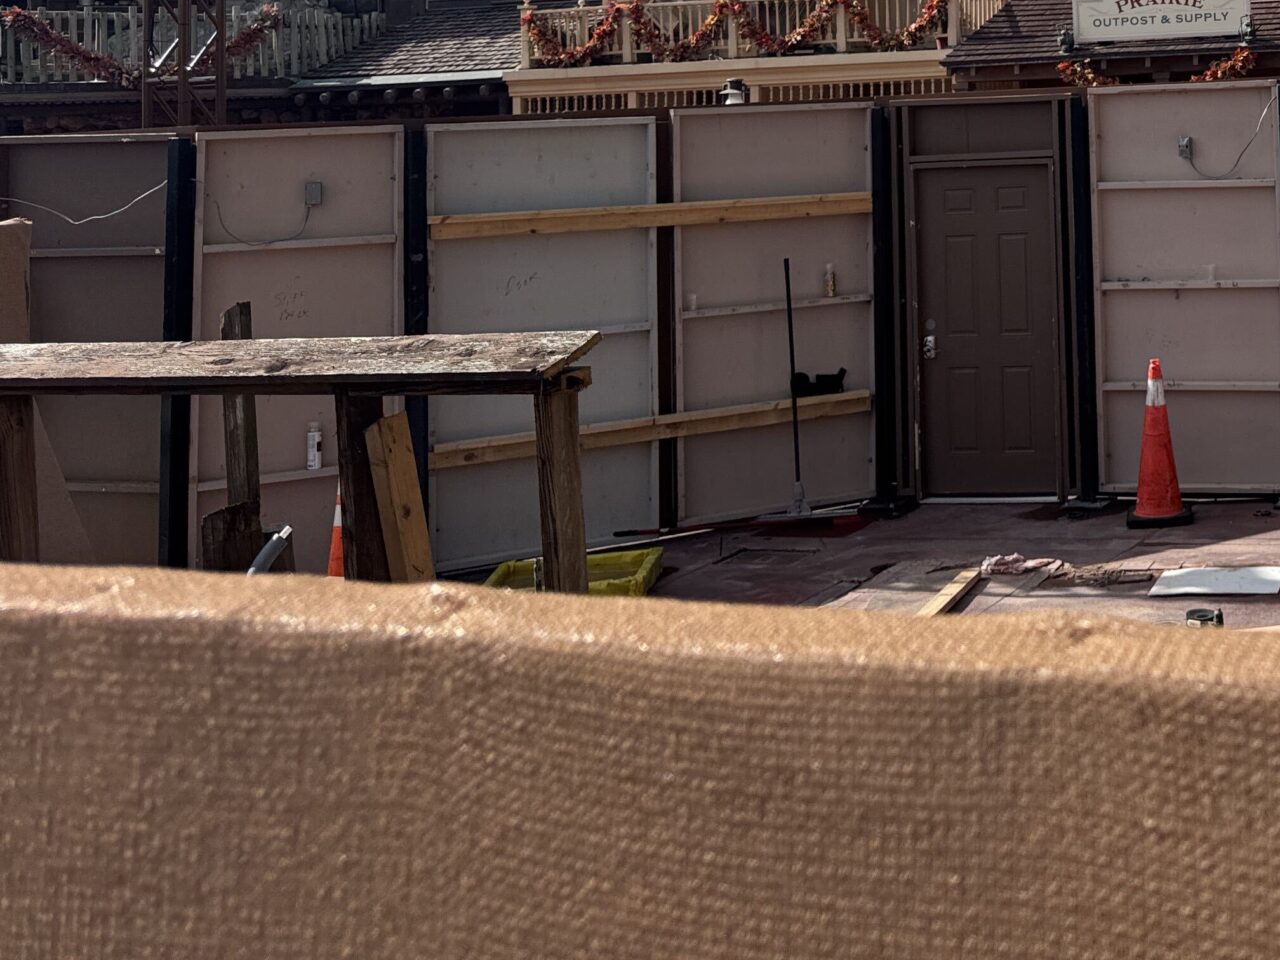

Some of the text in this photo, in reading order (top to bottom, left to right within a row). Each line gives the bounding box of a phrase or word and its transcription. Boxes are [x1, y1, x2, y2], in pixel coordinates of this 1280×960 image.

[1093, 12, 1229, 28] OUTPOST & SUPPLY
